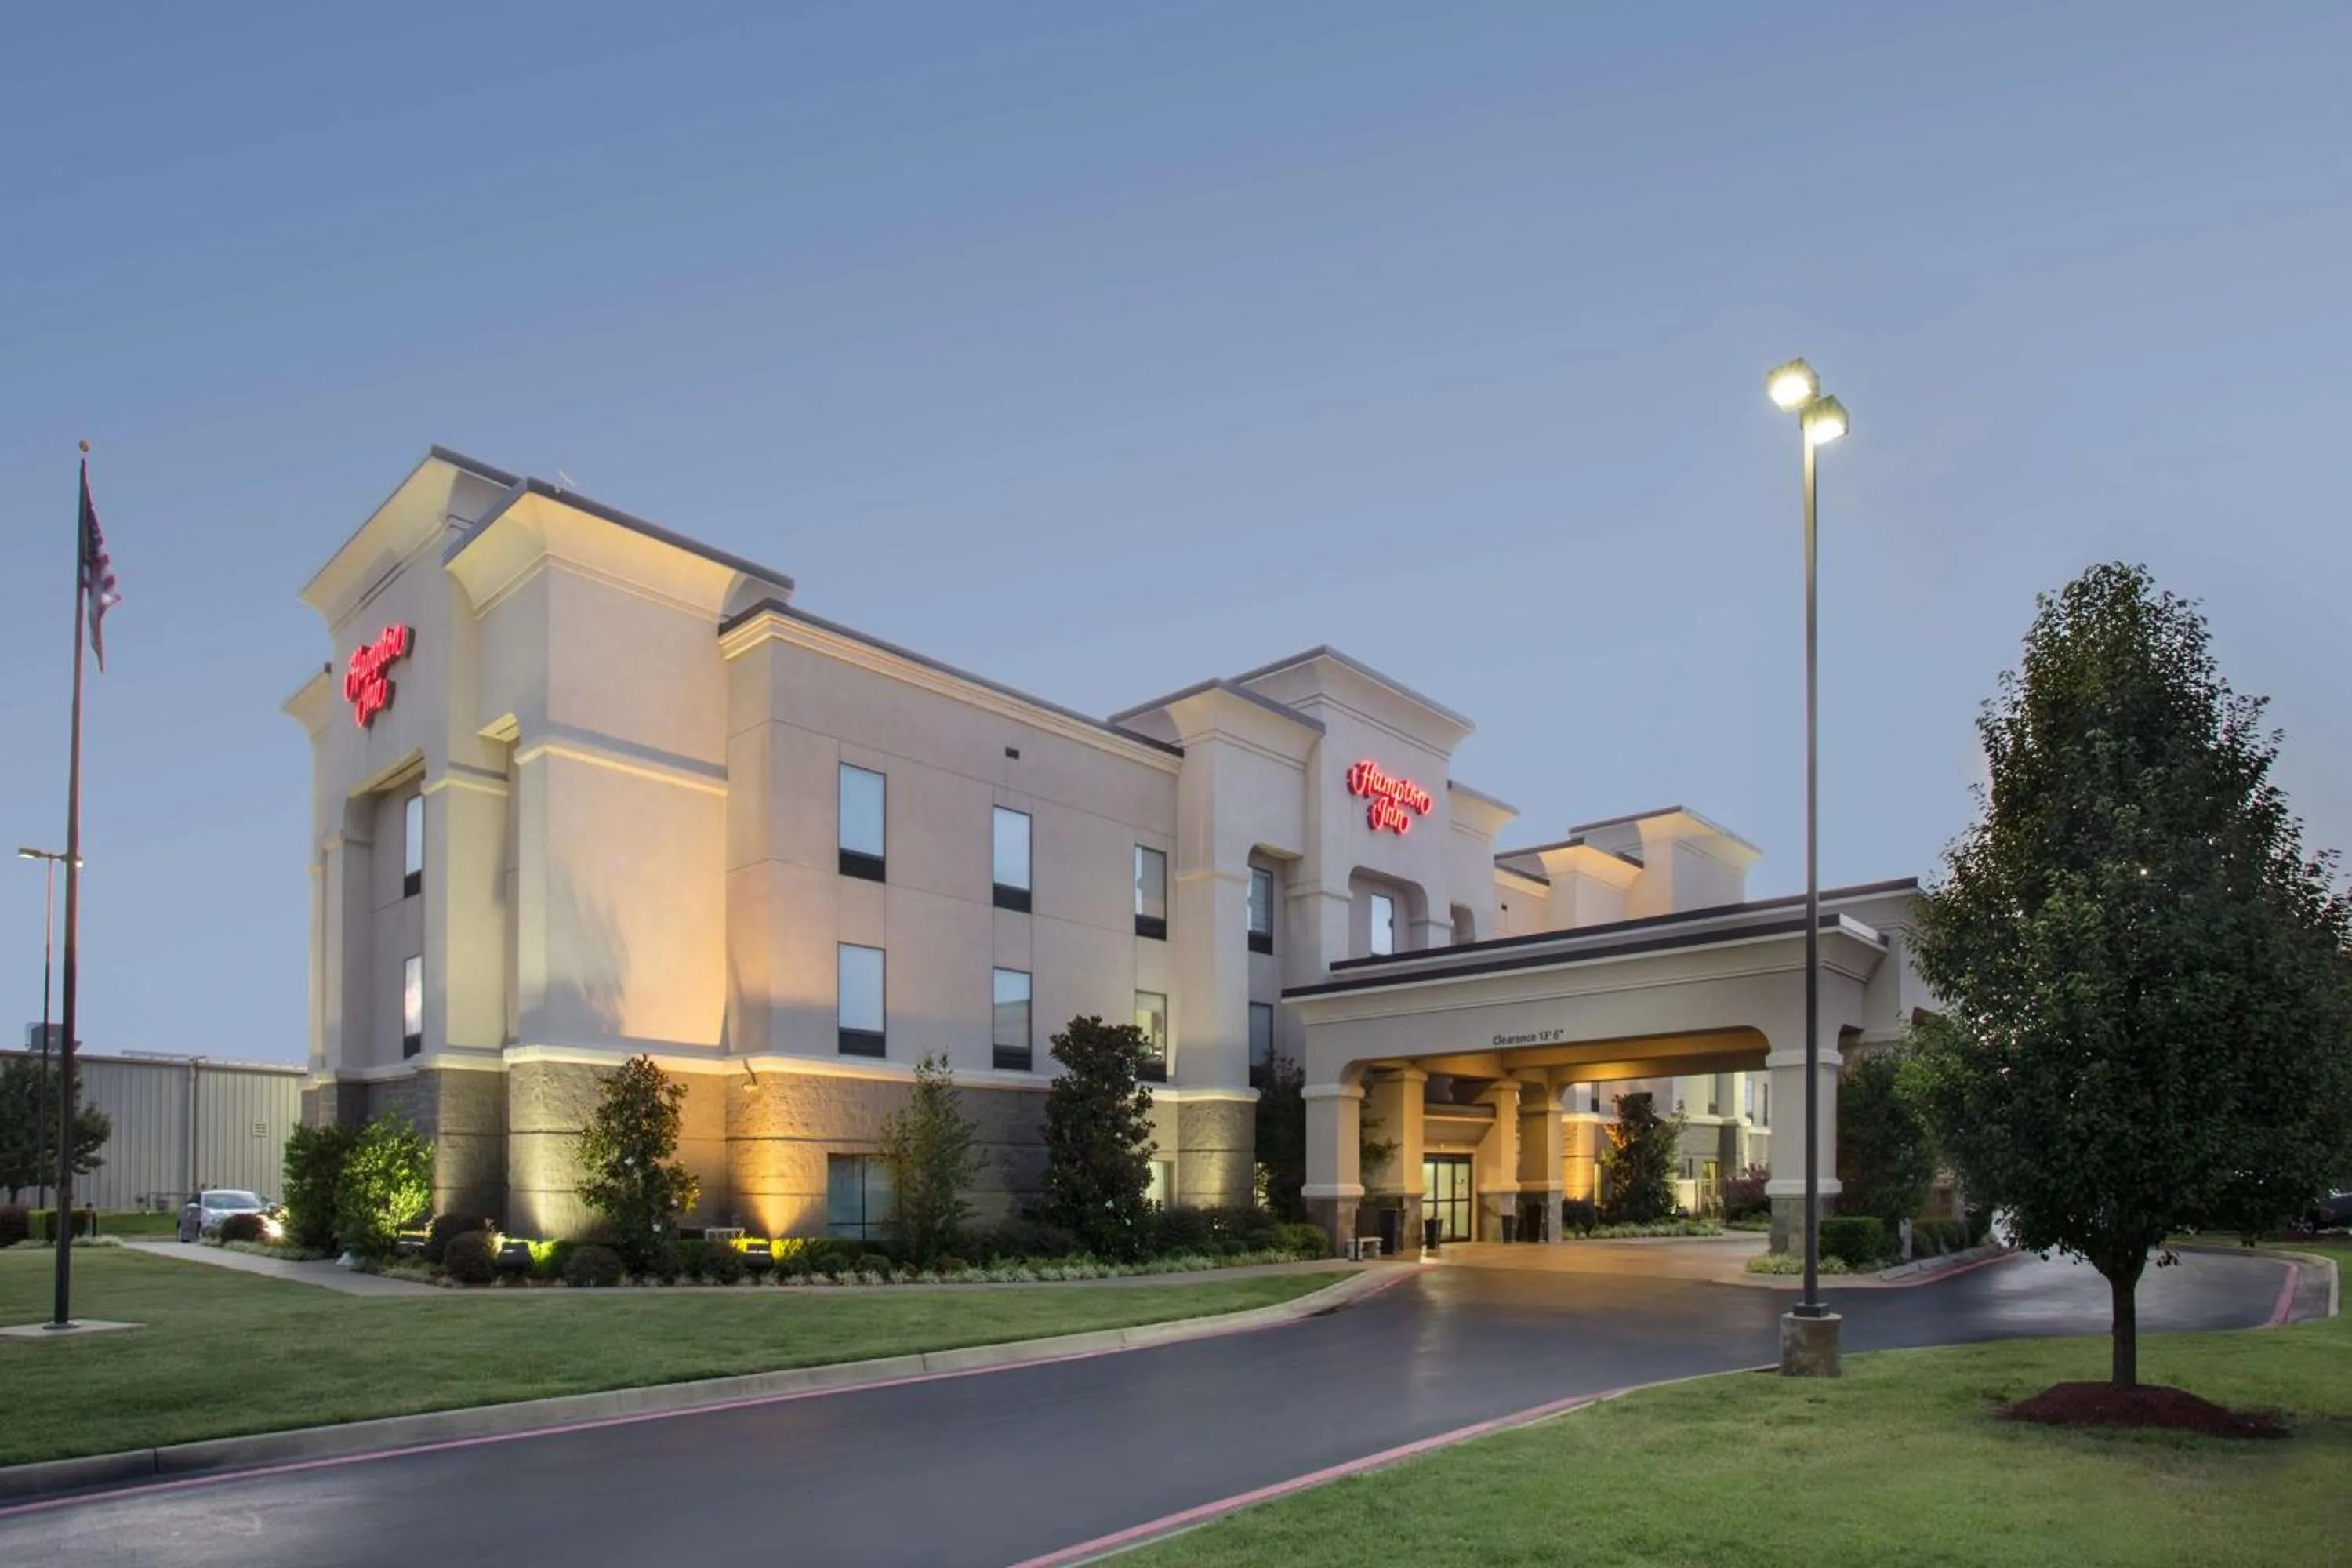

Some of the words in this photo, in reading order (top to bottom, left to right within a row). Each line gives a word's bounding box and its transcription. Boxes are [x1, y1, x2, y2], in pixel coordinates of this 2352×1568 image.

[1352, 760, 1431, 815] Hampton
[1373, 796, 1410, 834] Inn
[1492, 1033, 1537, 1045] Clearance
